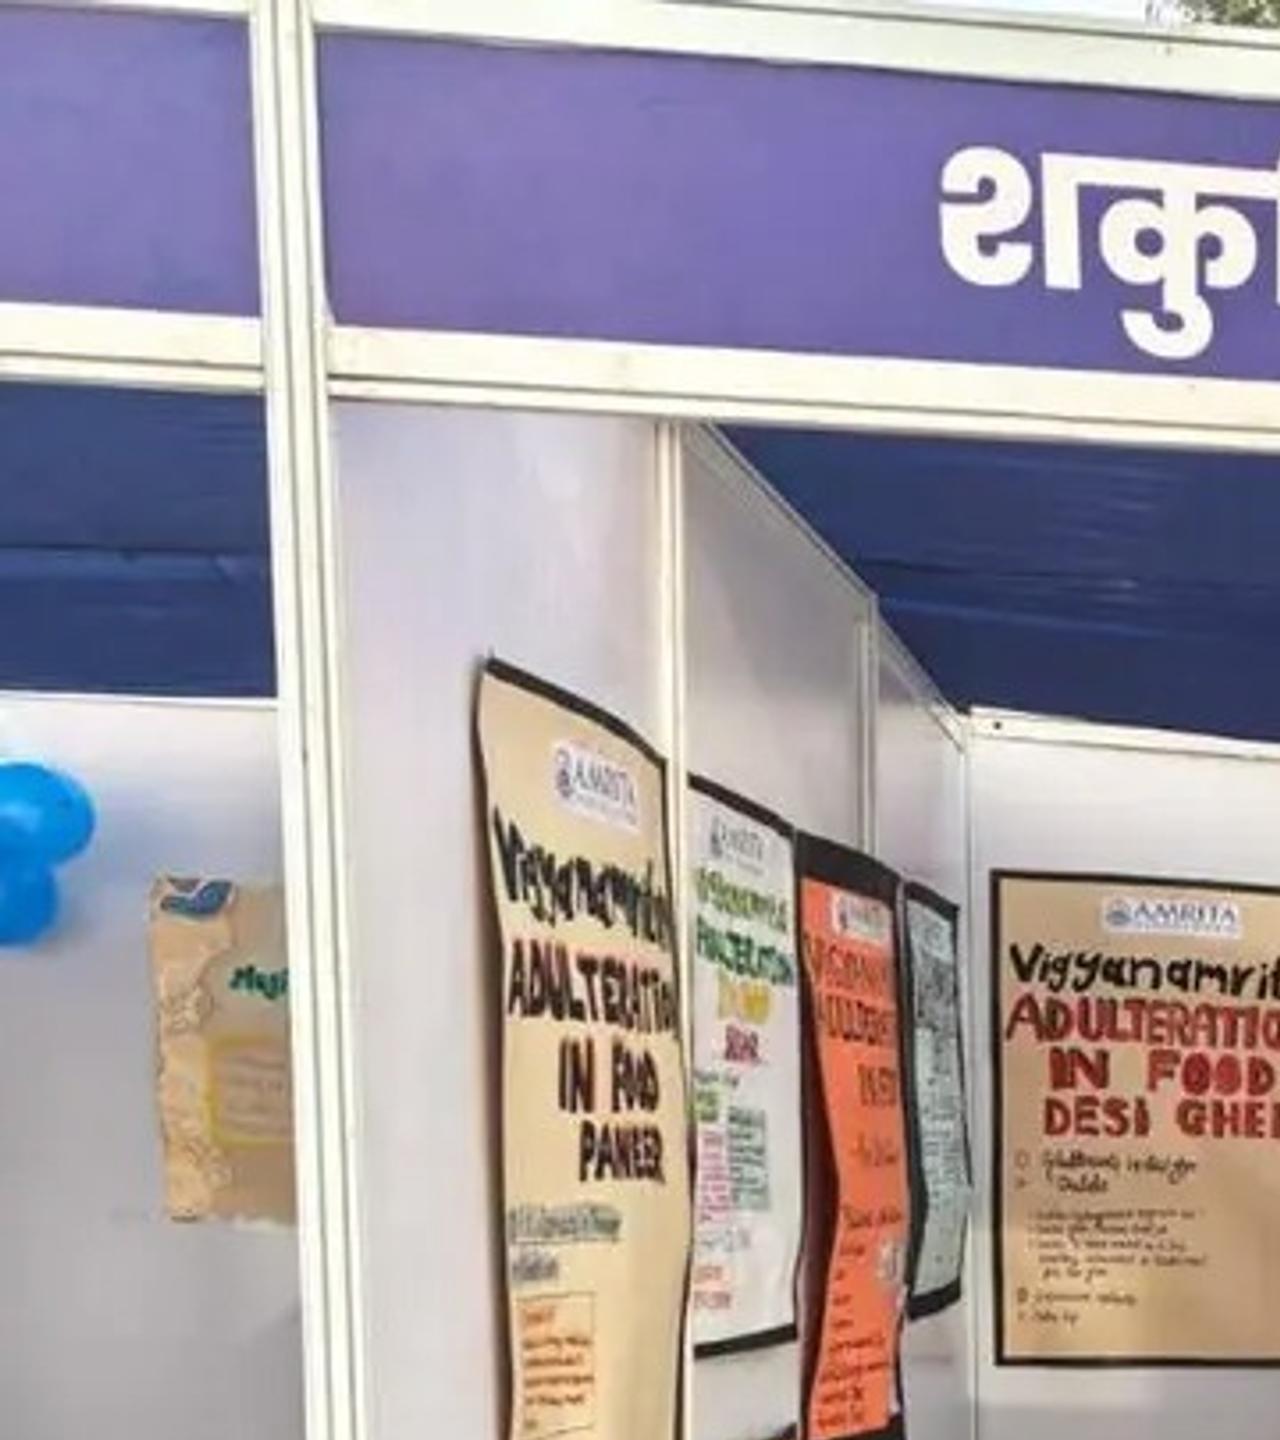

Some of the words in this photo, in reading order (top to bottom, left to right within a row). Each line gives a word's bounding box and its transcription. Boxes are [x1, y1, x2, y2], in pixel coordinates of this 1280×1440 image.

[558, 1037, 594, 1113] IN
[1050, 1046, 1110, 1092] IN
[1146, 1049, 1277, 1097] FOOD
[1043, 1096, 1153, 1137] DESI
